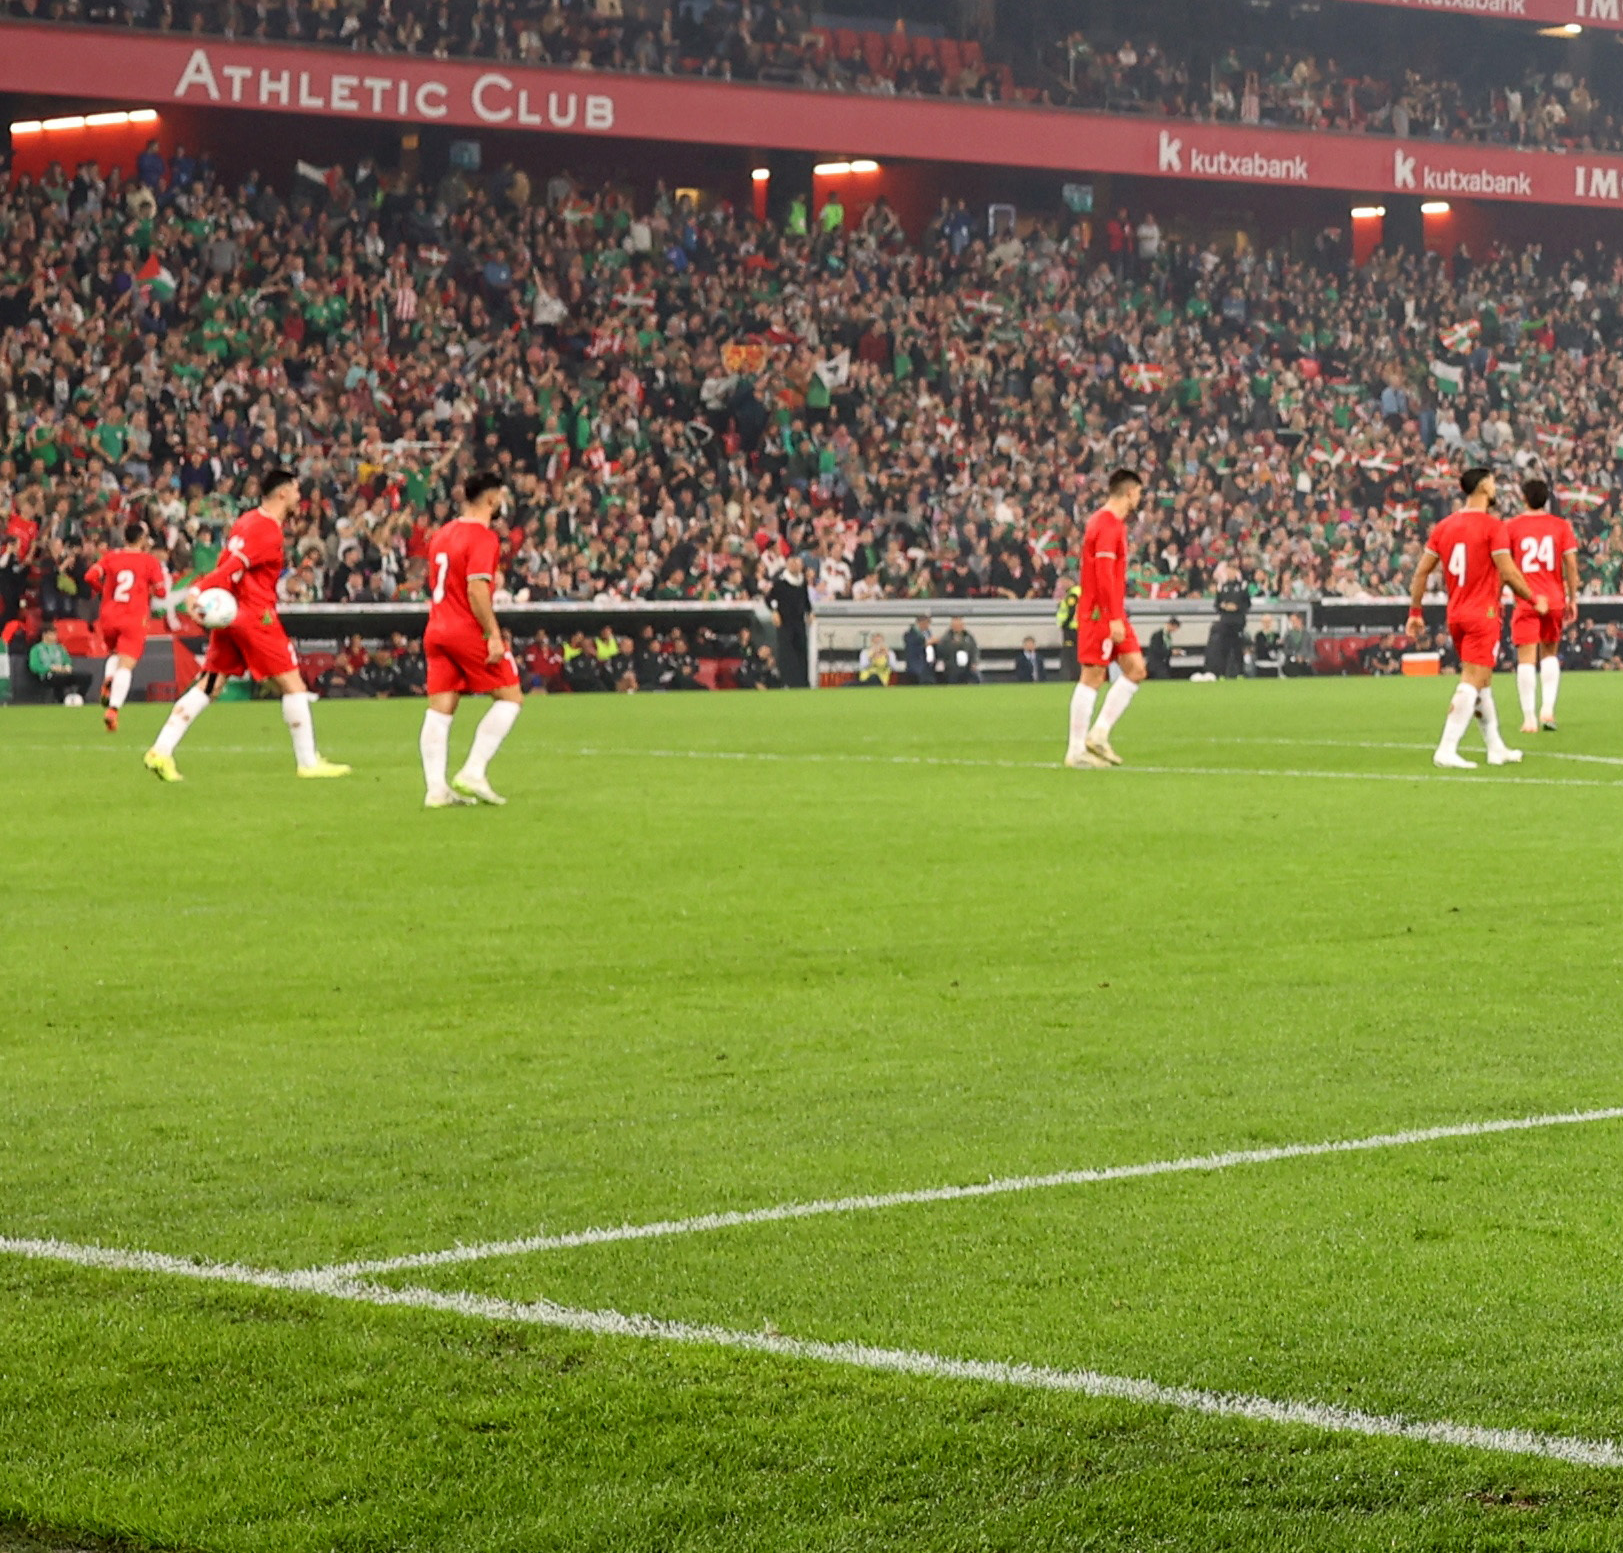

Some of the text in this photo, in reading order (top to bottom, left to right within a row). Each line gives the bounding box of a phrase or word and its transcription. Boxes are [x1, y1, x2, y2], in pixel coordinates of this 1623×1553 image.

[174, 49, 615, 131] ATHLETIC CLUB
[1190, 148, 1308, 181] kutxabank
[1423, 166, 1532, 196] kutxabank
[1449, 542, 1466, 588] 4
[1520, 535, 1555, 573] 24
[113, 569, 135, 603] 2
